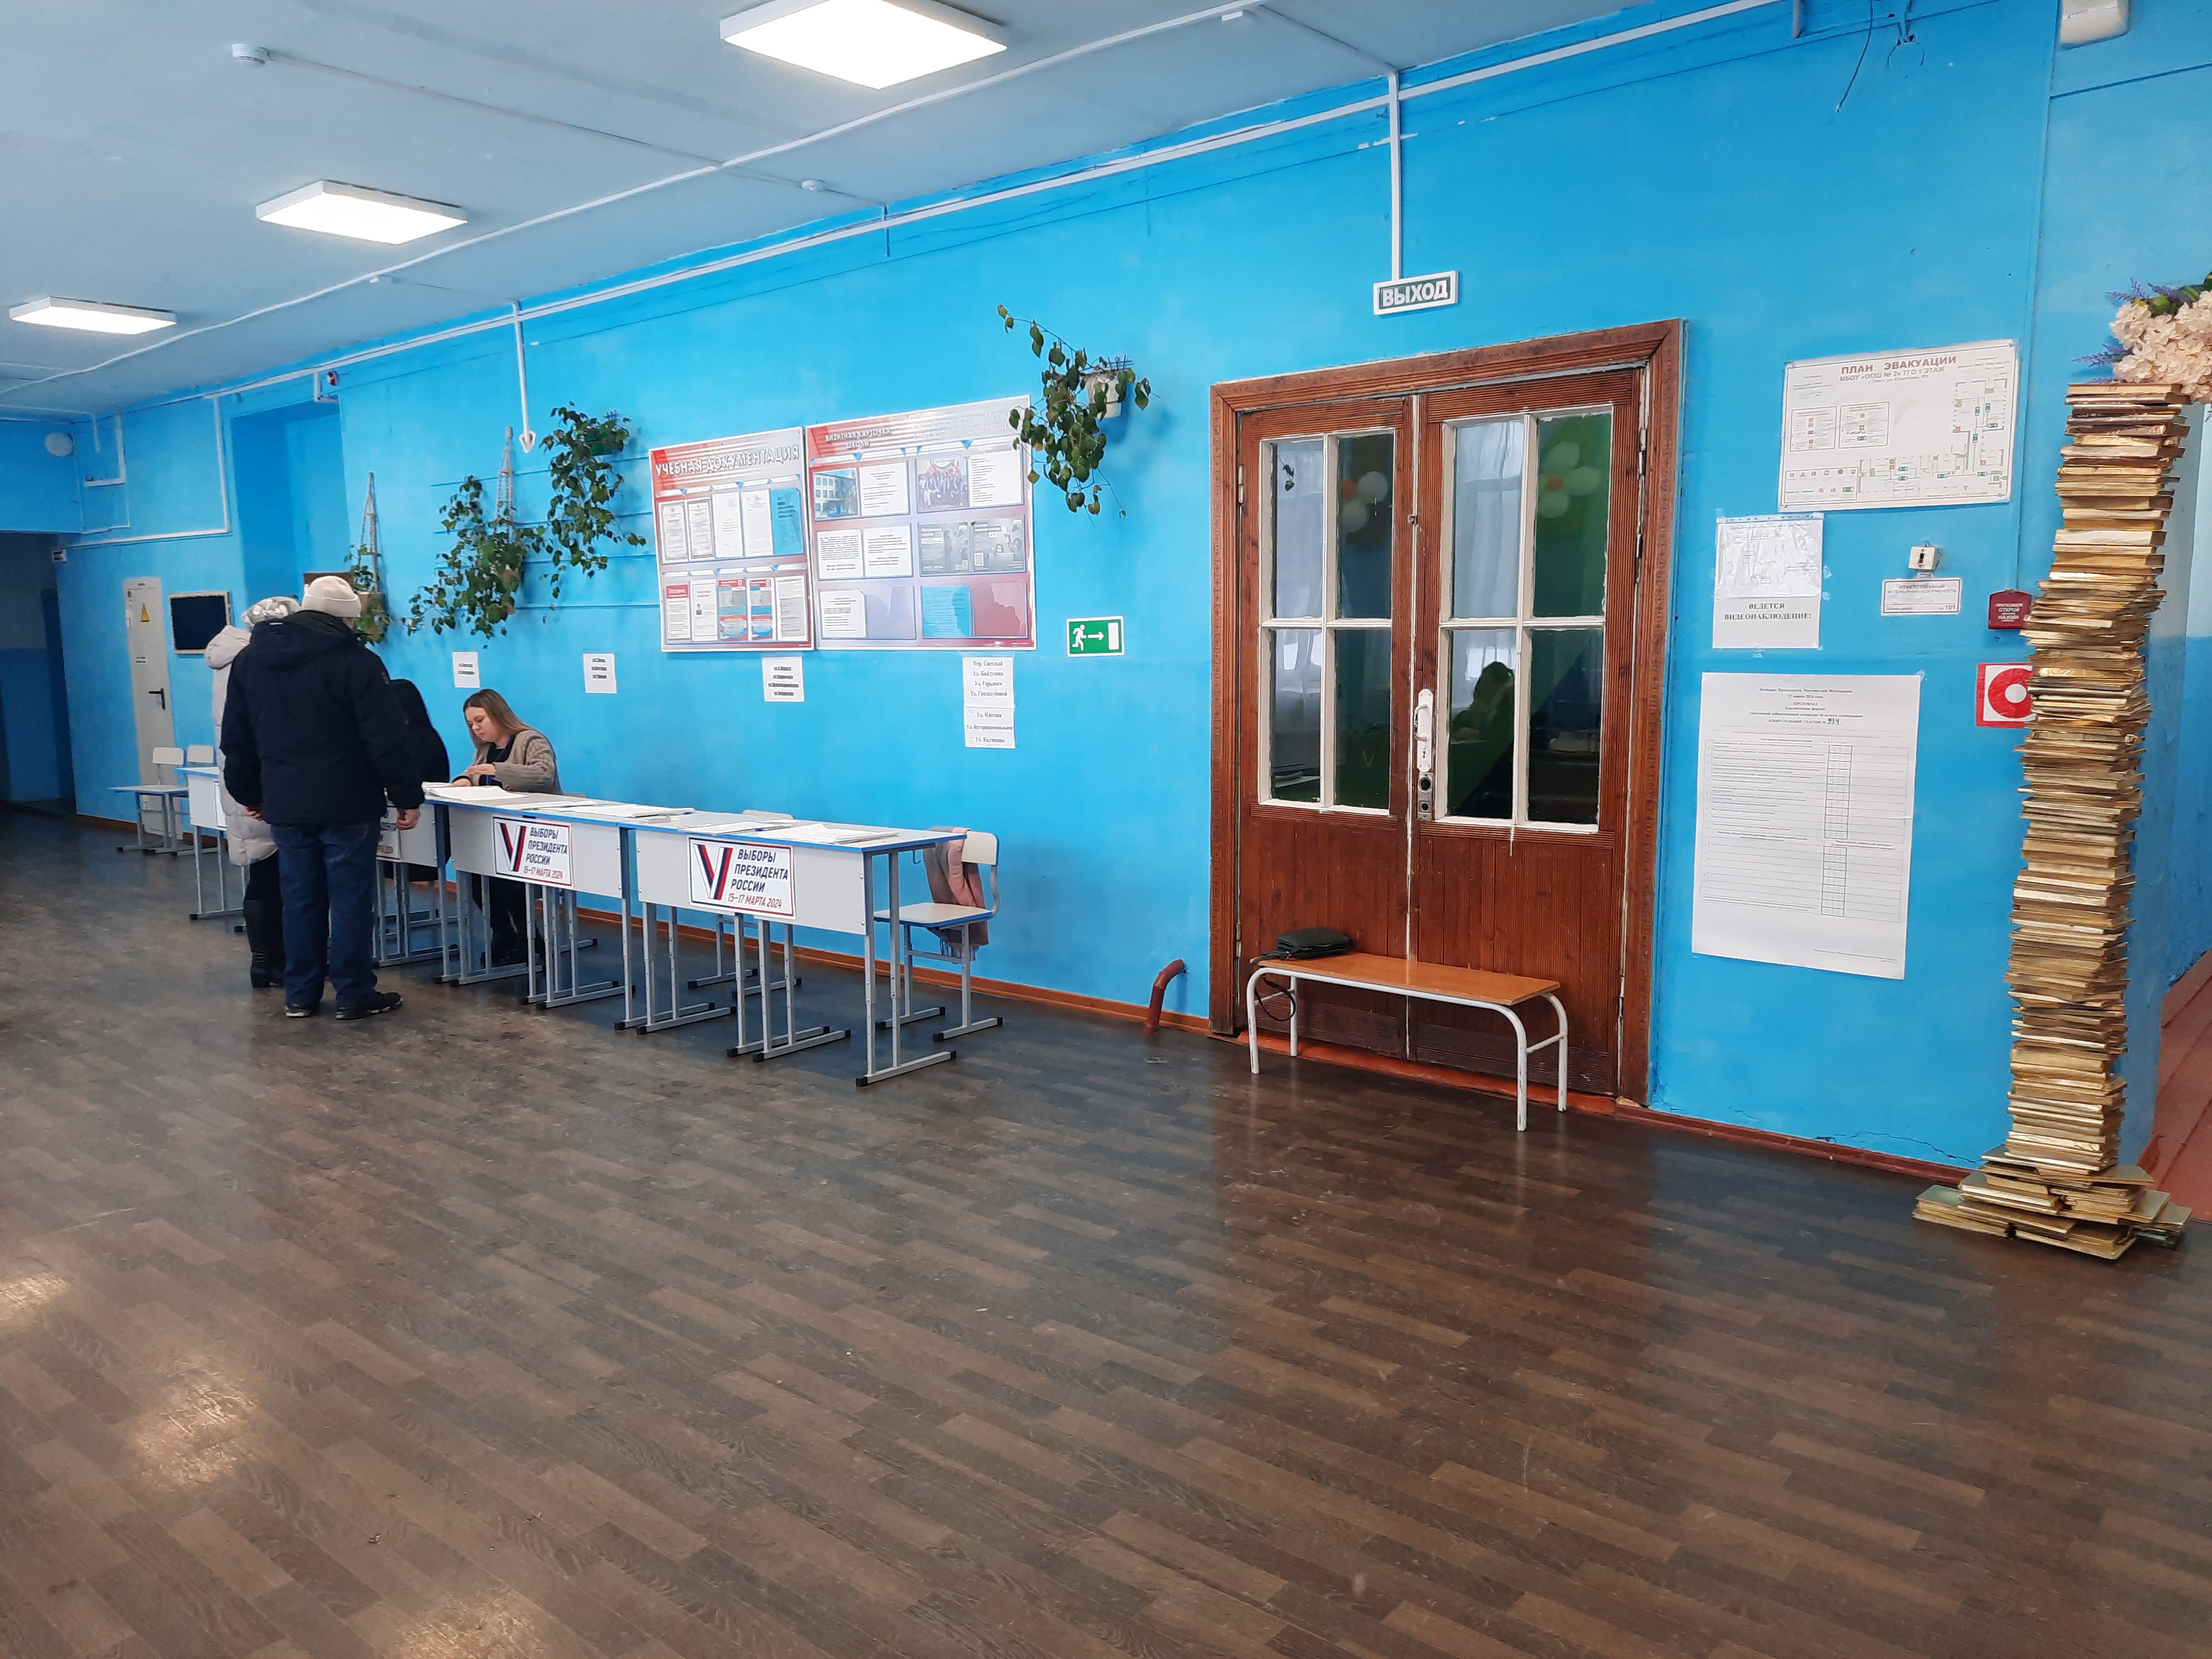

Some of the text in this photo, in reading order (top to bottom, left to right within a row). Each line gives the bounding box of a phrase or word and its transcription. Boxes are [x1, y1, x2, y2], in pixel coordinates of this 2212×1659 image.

[1383, 280, 1448, 307] ВЫХОД
[1841, 364, 1874, 375] ПЛАН
[1884, 356, 1957, 371] ЭВАКУАЦИИ
[825, 427, 892, 442] ВИЗИТНАЯ КАРТОЧКА
[846, 440, 870, 449] ШКОЛЫ
[655, 444, 800, 477] УЧЕБНАЯ ДОКУМЕНТАЦИЯ
[1724, 612, 1813, 620] ВИДЕОНАБЛЮДЕНИЕ!
[529, 826, 559, 840] ВЫБОРЫ
[528, 839, 568, 855] ПРЕЗИДЕНТА
[525, 853, 551, 866] РОССИИ
[737, 848, 777, 863] ВЫБОРЫ
[734, 863, 789, 880] ПРЕЗИДЕНТА
[730, 878, 766, 893] РОССИИ
[745, 895, 765, 907] МАРТА
[766, 898, 782, 909] 2024
